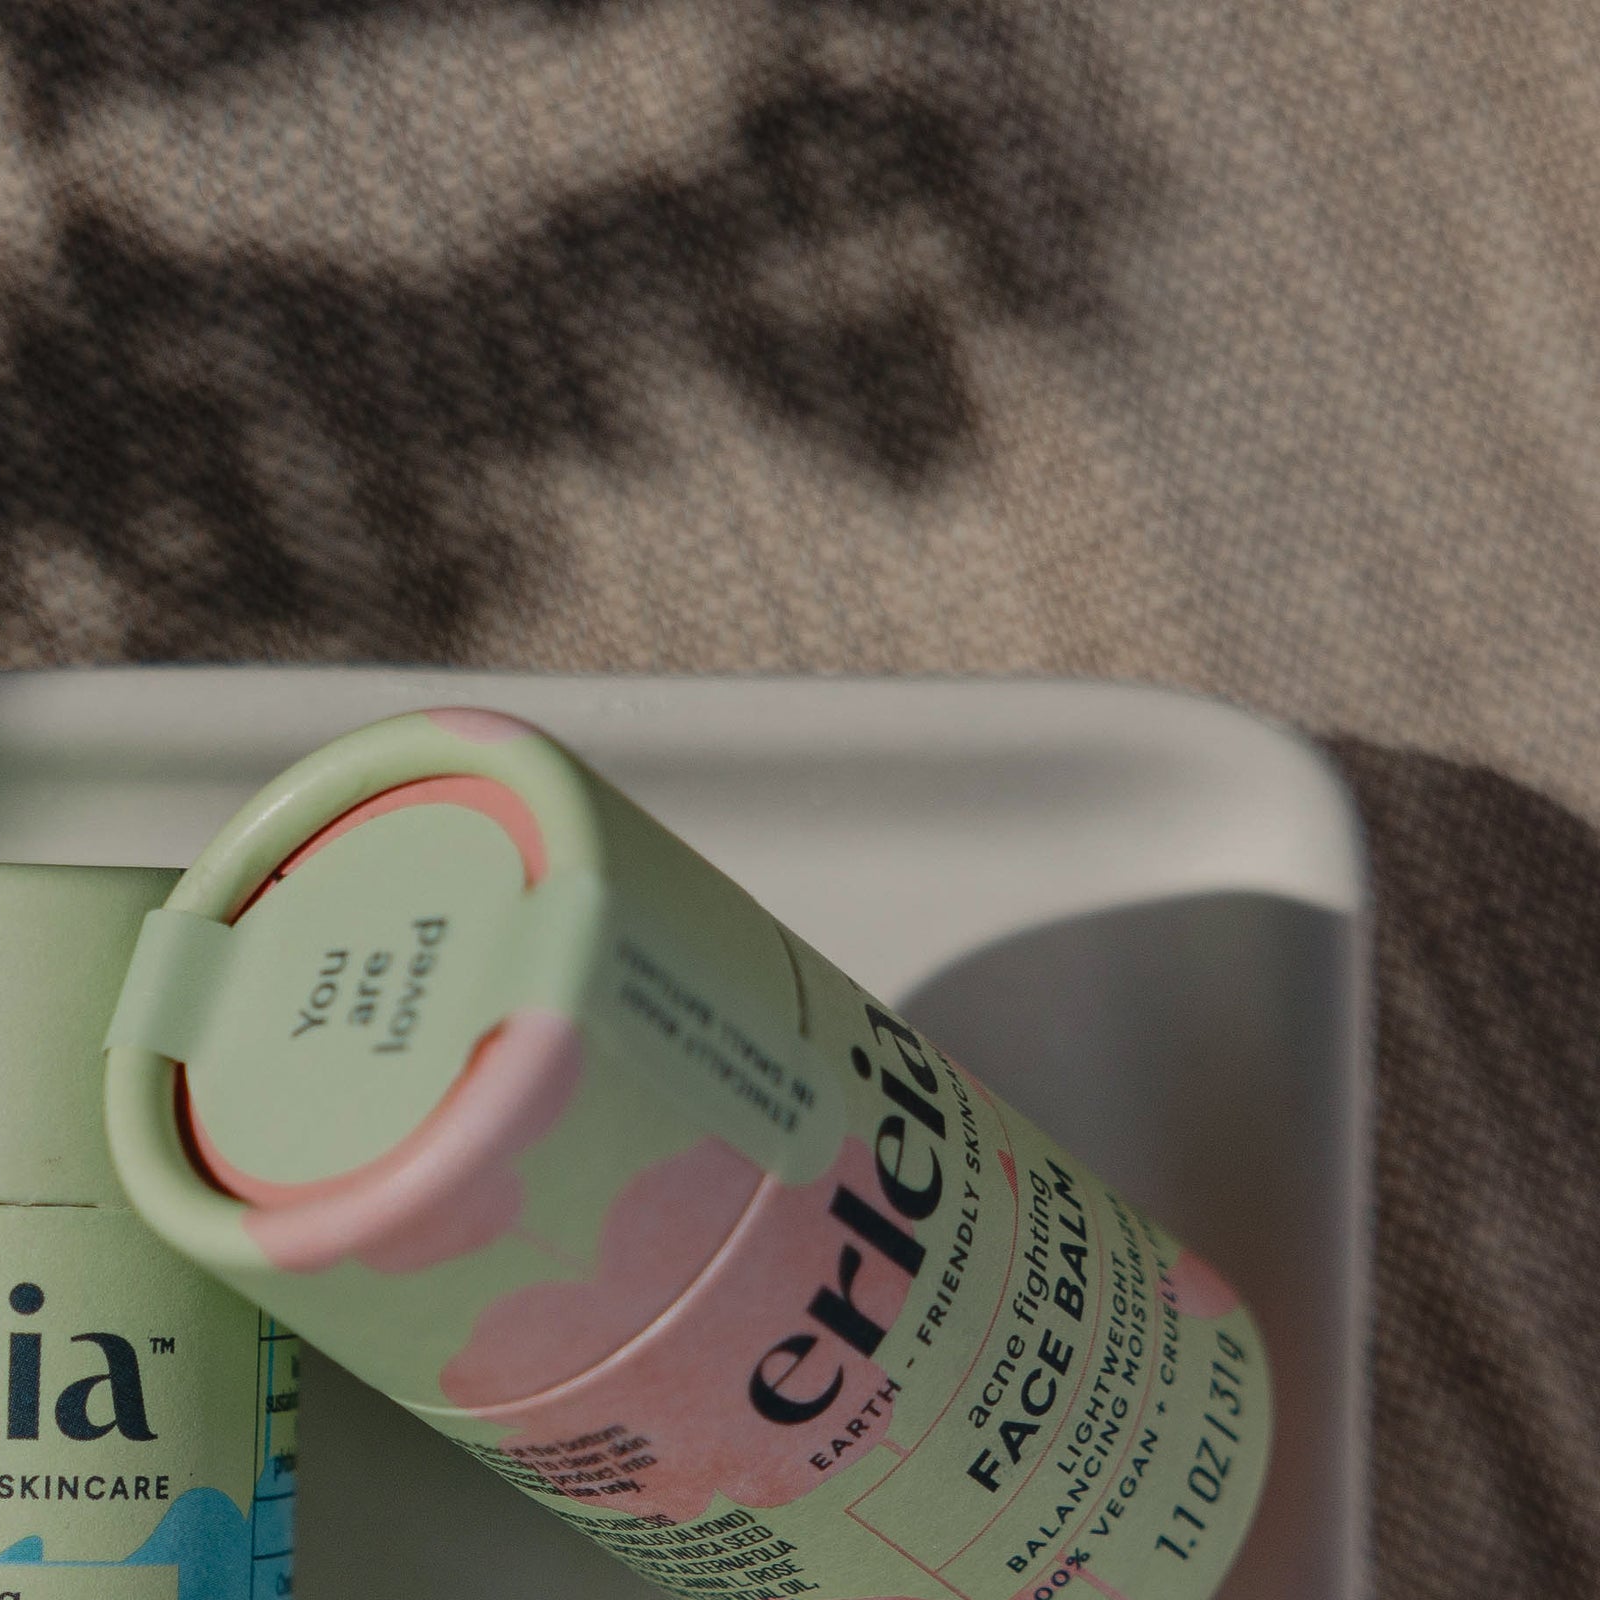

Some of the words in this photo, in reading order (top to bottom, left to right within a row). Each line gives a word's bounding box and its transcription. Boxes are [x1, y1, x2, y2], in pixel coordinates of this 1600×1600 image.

[291, 948, 349, 1038] You
[348, 950, 394, 1026] are
[370, 917, 449, 1055] loved
[935, 1050, 982, 1175] SKINCA
[749, 1003, 946, 1426] erleia
[916, 1180, 981, 1347] FRIENDLY
[966, 1328, 1075, 1494] FACE
[1045, 1158, 1088, 1322] BALM
[967, 1333, 1026, 1429] acne
[1012, 1169, 1053, 1326] fighting
[1056, 1250, 1127, 1475] LIGHTWEIGHT
[808, 1378, 902, 1472] EARTH
[1089, 1427, 1159, 1537] VEGAN
[666, 1509, 757, 1545] (ALMOND)
[667, 1541, 730, 1561] INDICA
[721, 1525, 774, 1550] SEED
[1005, 1396, 1129, 1574] BALANCING
[673, 1539, 798, 1576] ALTERNAFOLIA
[743, 1558, 805, 1586] (ROSE
